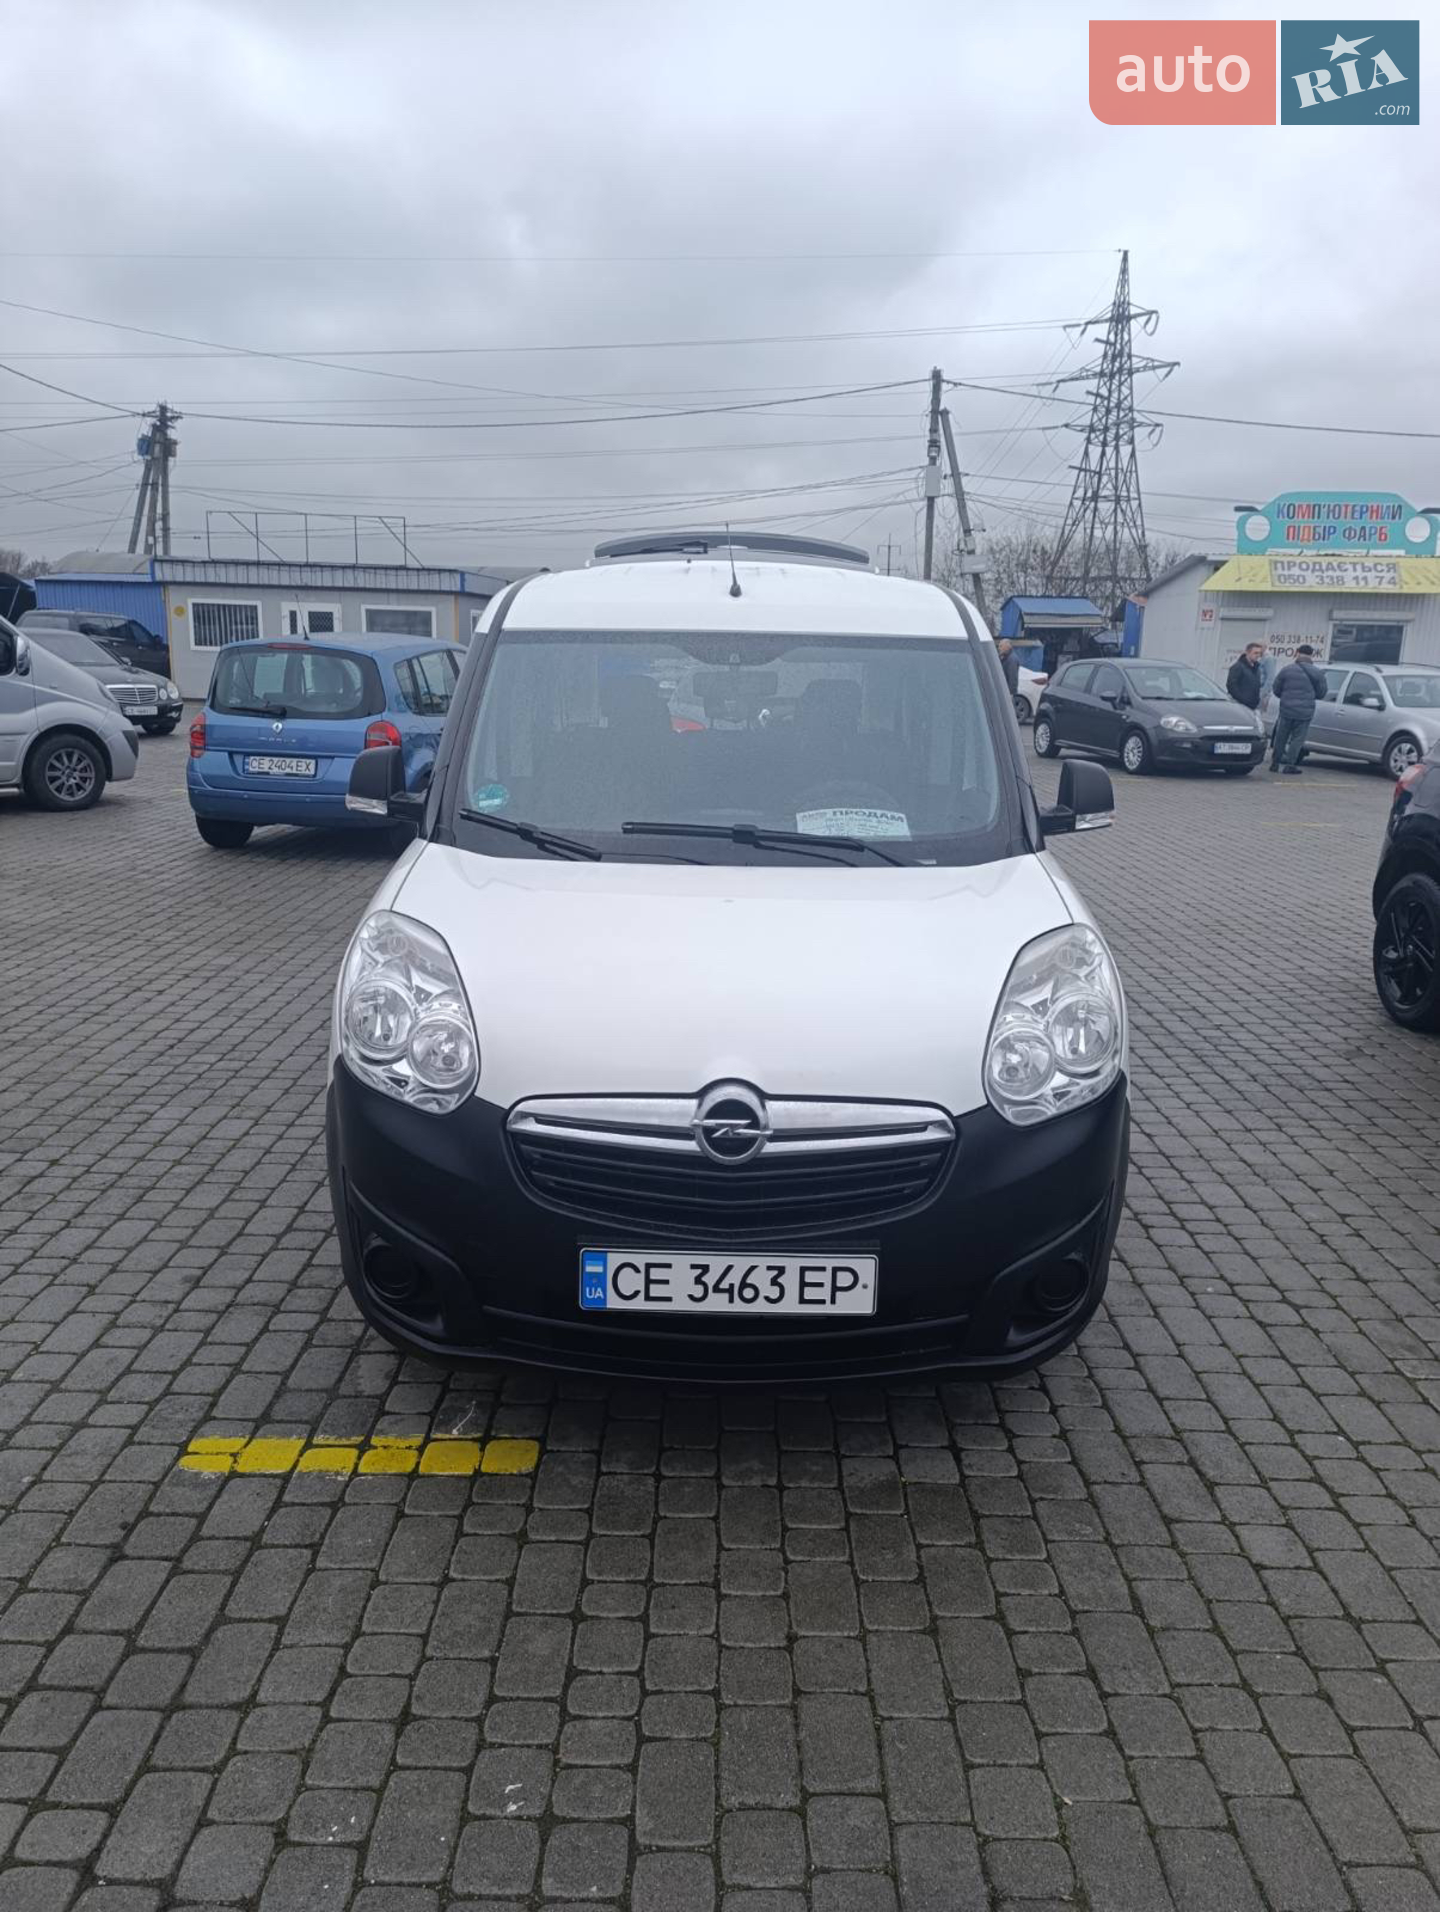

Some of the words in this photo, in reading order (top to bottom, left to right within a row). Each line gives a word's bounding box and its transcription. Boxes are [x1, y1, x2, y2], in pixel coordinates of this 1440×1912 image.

[1286, 525, 1337, 543] ПІДБІР
[1342, 525, 1388, 542] ФАРБ
[1273, 560, 1397, 574] ПРОДАЄТЬСЯ
[1277, 573, 1306, 585] 050
[1315, 574, 1345, 586] 338
[1352, 575, 1368, 586] 11
[250, 757, 265, 770] CE
[268, 758, 294, 771] 2404
[611, 1261, 673, 1302] CE
[686, 1263, 787, 1304] 3463
[798, 1265, 860, 1305] EP
[585, 1286, 605, 1299] UA
